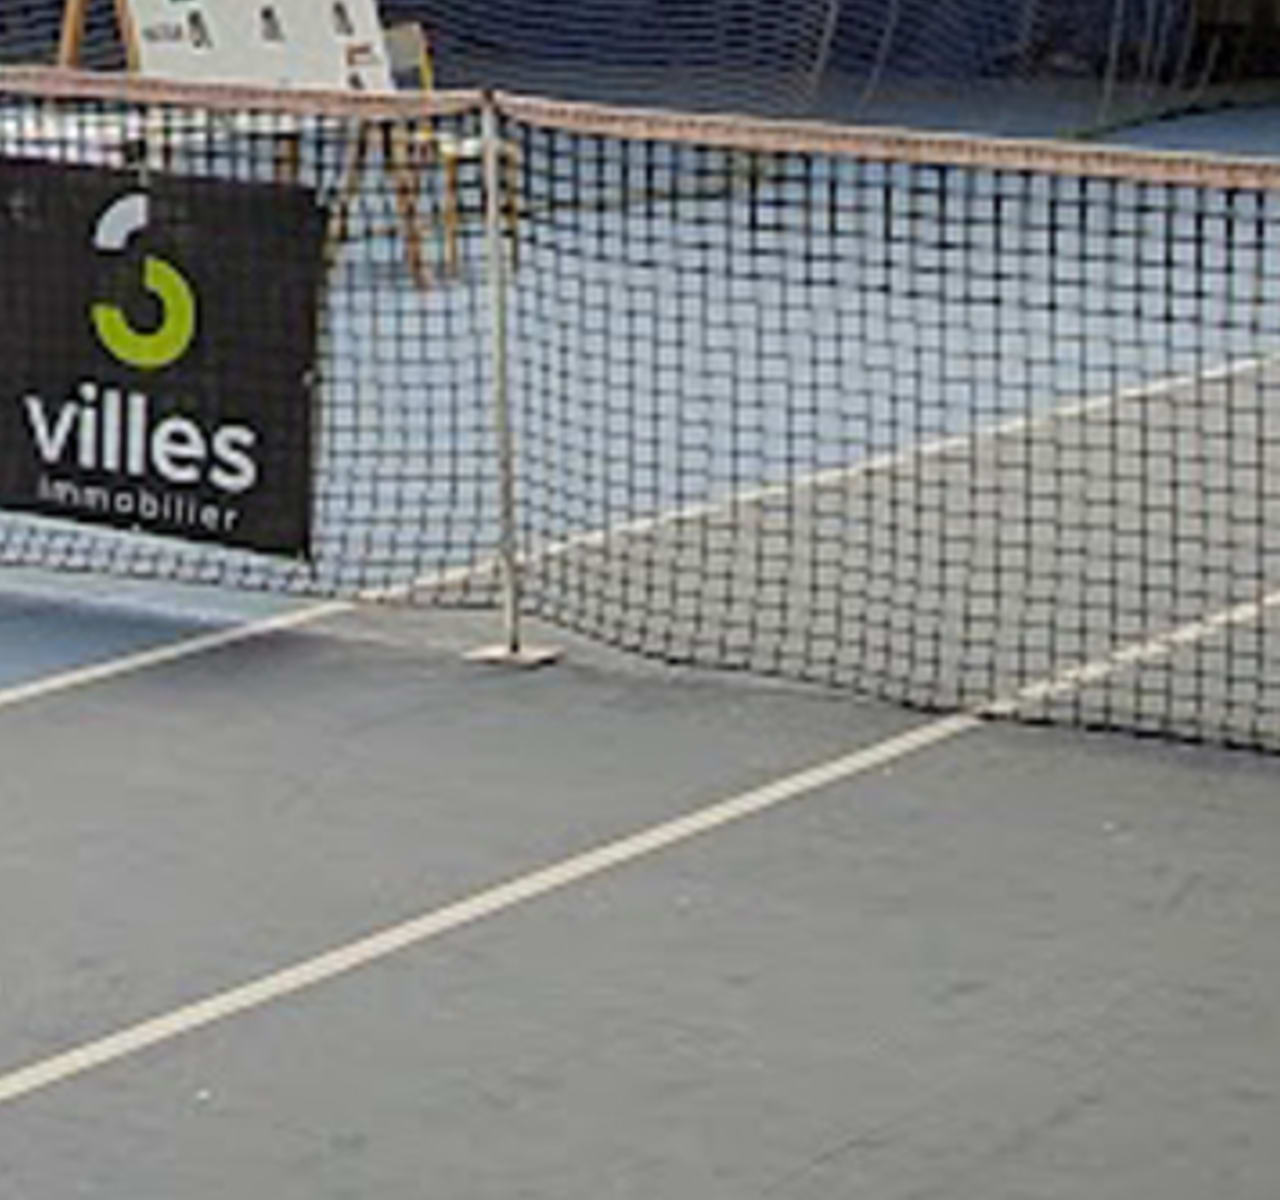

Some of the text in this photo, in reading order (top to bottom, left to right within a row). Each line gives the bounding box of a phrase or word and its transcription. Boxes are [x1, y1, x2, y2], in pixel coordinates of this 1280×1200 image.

[90, 192, 196, 370] 3
[24, 383, 258, 492] villes
[39, 475, 240, 532] immobilier
